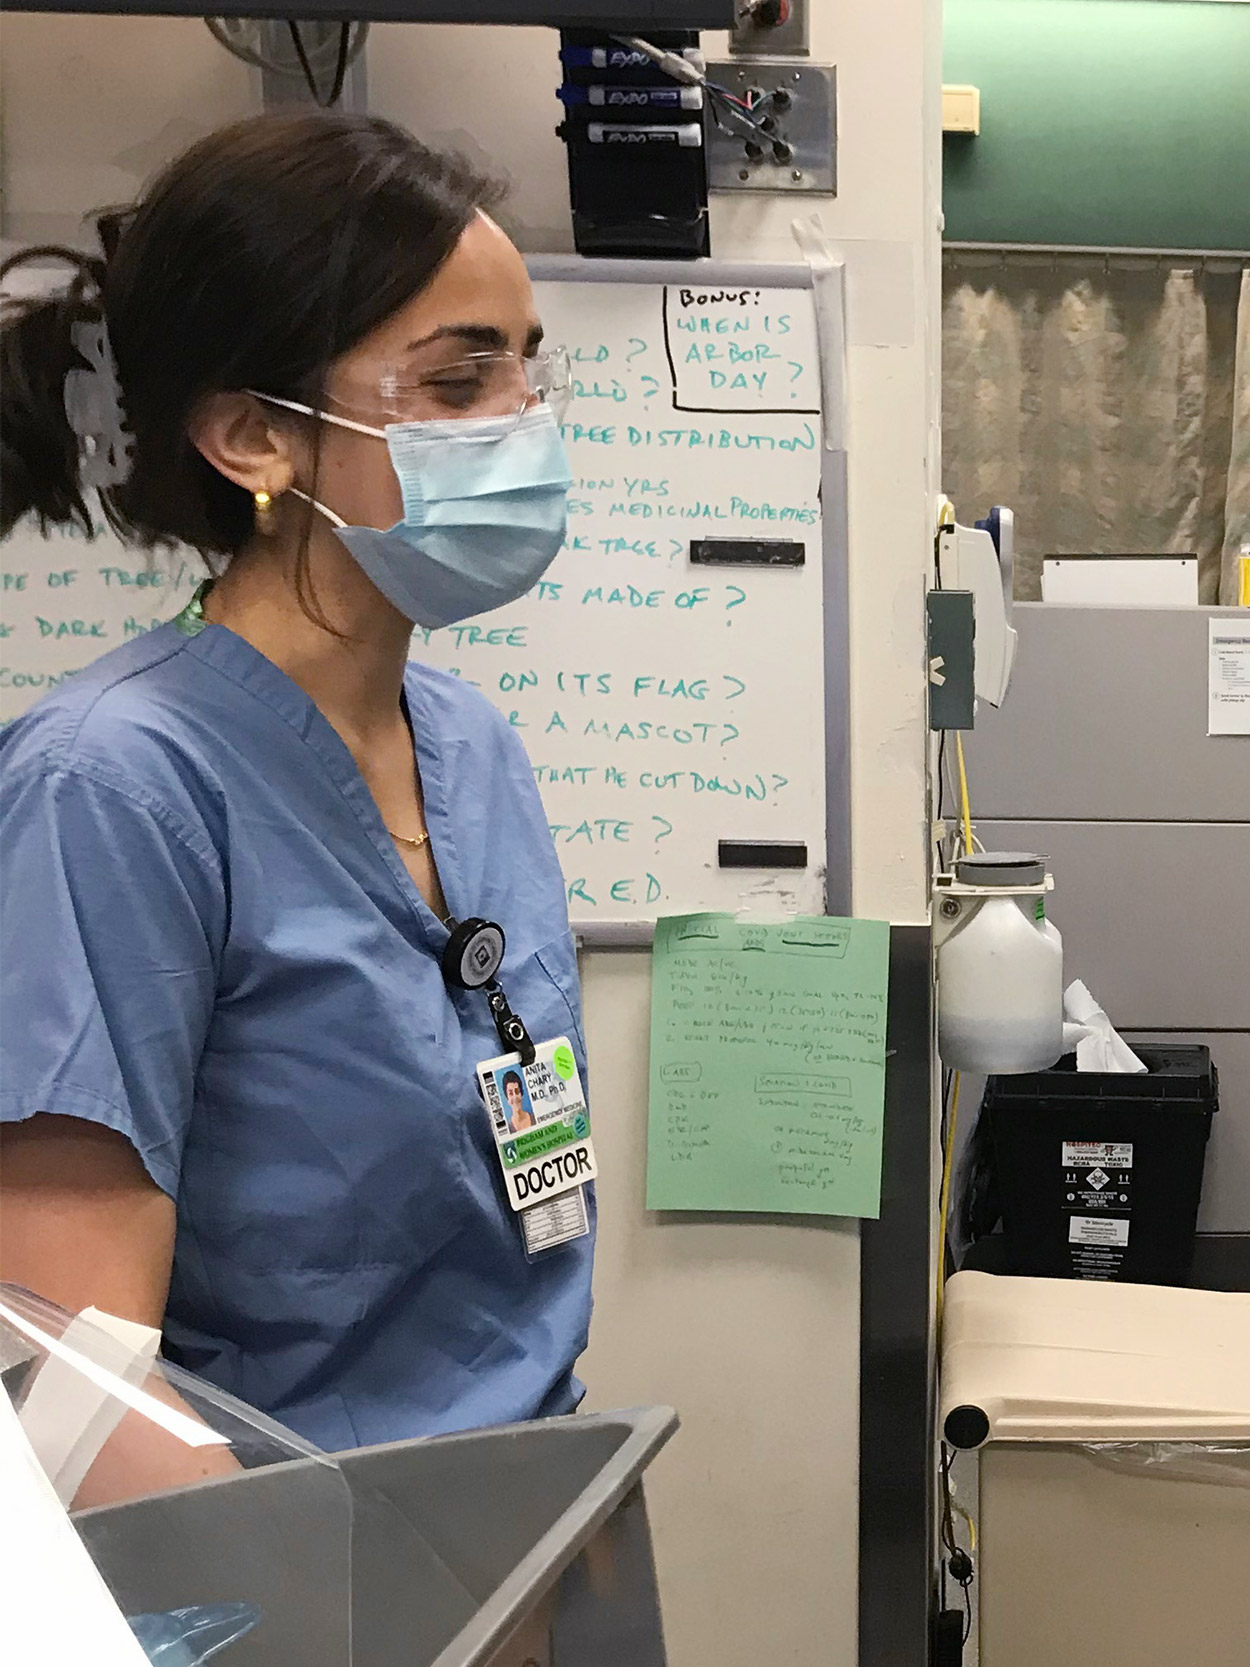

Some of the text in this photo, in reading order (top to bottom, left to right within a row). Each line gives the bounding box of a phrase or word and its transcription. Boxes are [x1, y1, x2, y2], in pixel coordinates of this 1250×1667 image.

[680, 289, 760, 307] BONUS:
[677, 315, 791, 334] WHEN IS
[571, 345, 609, 362] LD
[685, 342, 781, 363] ARBOR
[571, 379, 627, 402] RLD
[709, 370, 767, 390] DAY
[628, 423, 815, 450] DISTRIBUTION
[570, 477, 669, 496] ION YRS
[566, 496, 819, 525] ES MEDICINAL PROPERTIES
[47, 569, 79, 587] OF
[581, 585, 665, 607] MADE
[674, 588, 710, 609] OF
[725, 585, 746, 627] ?
[35, 616, 108, 640] DARK
[449, 626, 528, 649] TREE
[499, 670, 538, 692] ON
[557, 672, 611, 695] ITS
[633, 677, 711, 697] FLAG
[545, 711, 568, 733] A
[533, 765, 597, 785] THAT
[604, 766, 627, 788] HE
[639, 771, 685, 789] CUT
[549, 819, 633, 844] TATE
[525, 1062, 546, 1076] ANITA
[528, 1073, 551, 1089] CHARY
[513, 1147, 592, 1200] DOCTOR
